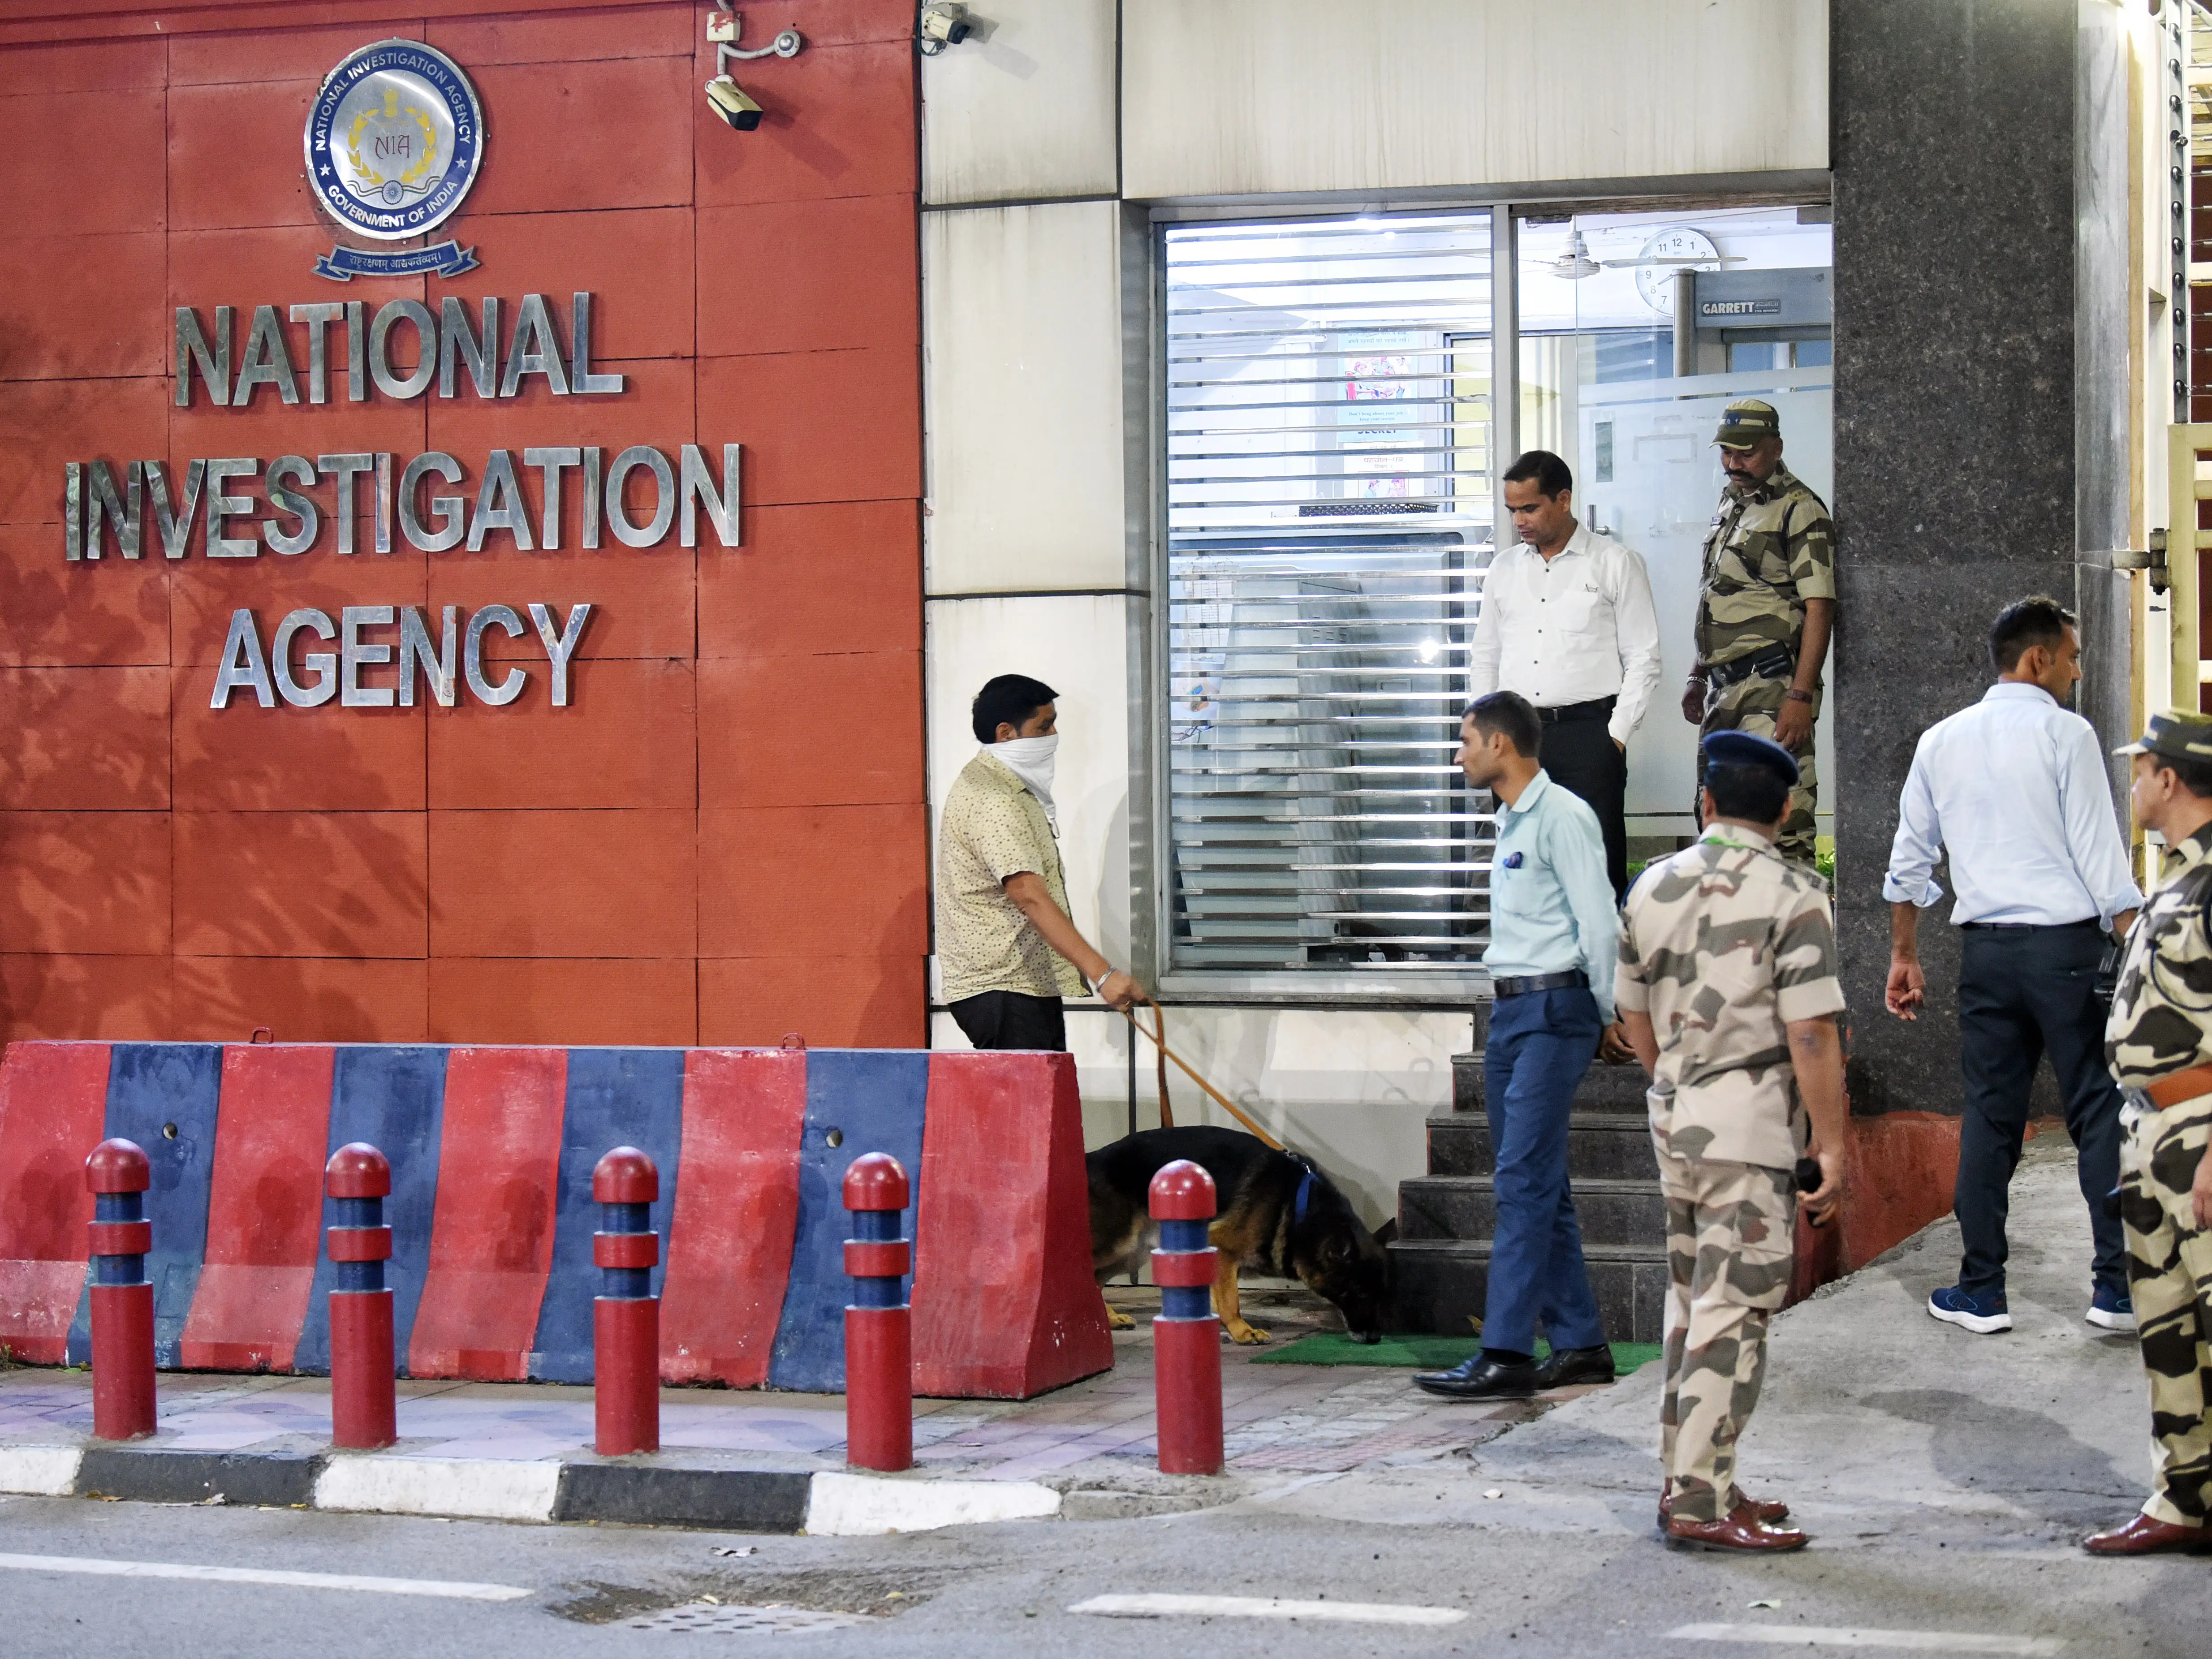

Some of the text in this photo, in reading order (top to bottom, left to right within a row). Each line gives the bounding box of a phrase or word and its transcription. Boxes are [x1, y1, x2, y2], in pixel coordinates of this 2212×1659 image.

[315, 53, 470, 151] NATIONAL INVESTIGATION AGENCY
[375, 135, 410, 159] NIA
[328, 181, 458, 228] GOVERNMENT OF INDIA
[1658, 243, 1667, 252] 11
[1672, 238, 1682, 247] 12
[1690, 241, 1695, 250] 1
[1646, 270, 1651, 279] 9
[1650, 285, 1656, 294] 8
[1661, 295, 1667, 304] 7
[1703, 302, 1755, 314] GARRETT
[175, 292, 624, 406] NATIONAL
[65, 444, 740, 560] INVESTIGATION
[209, 603, 591, 708] AGENCY
